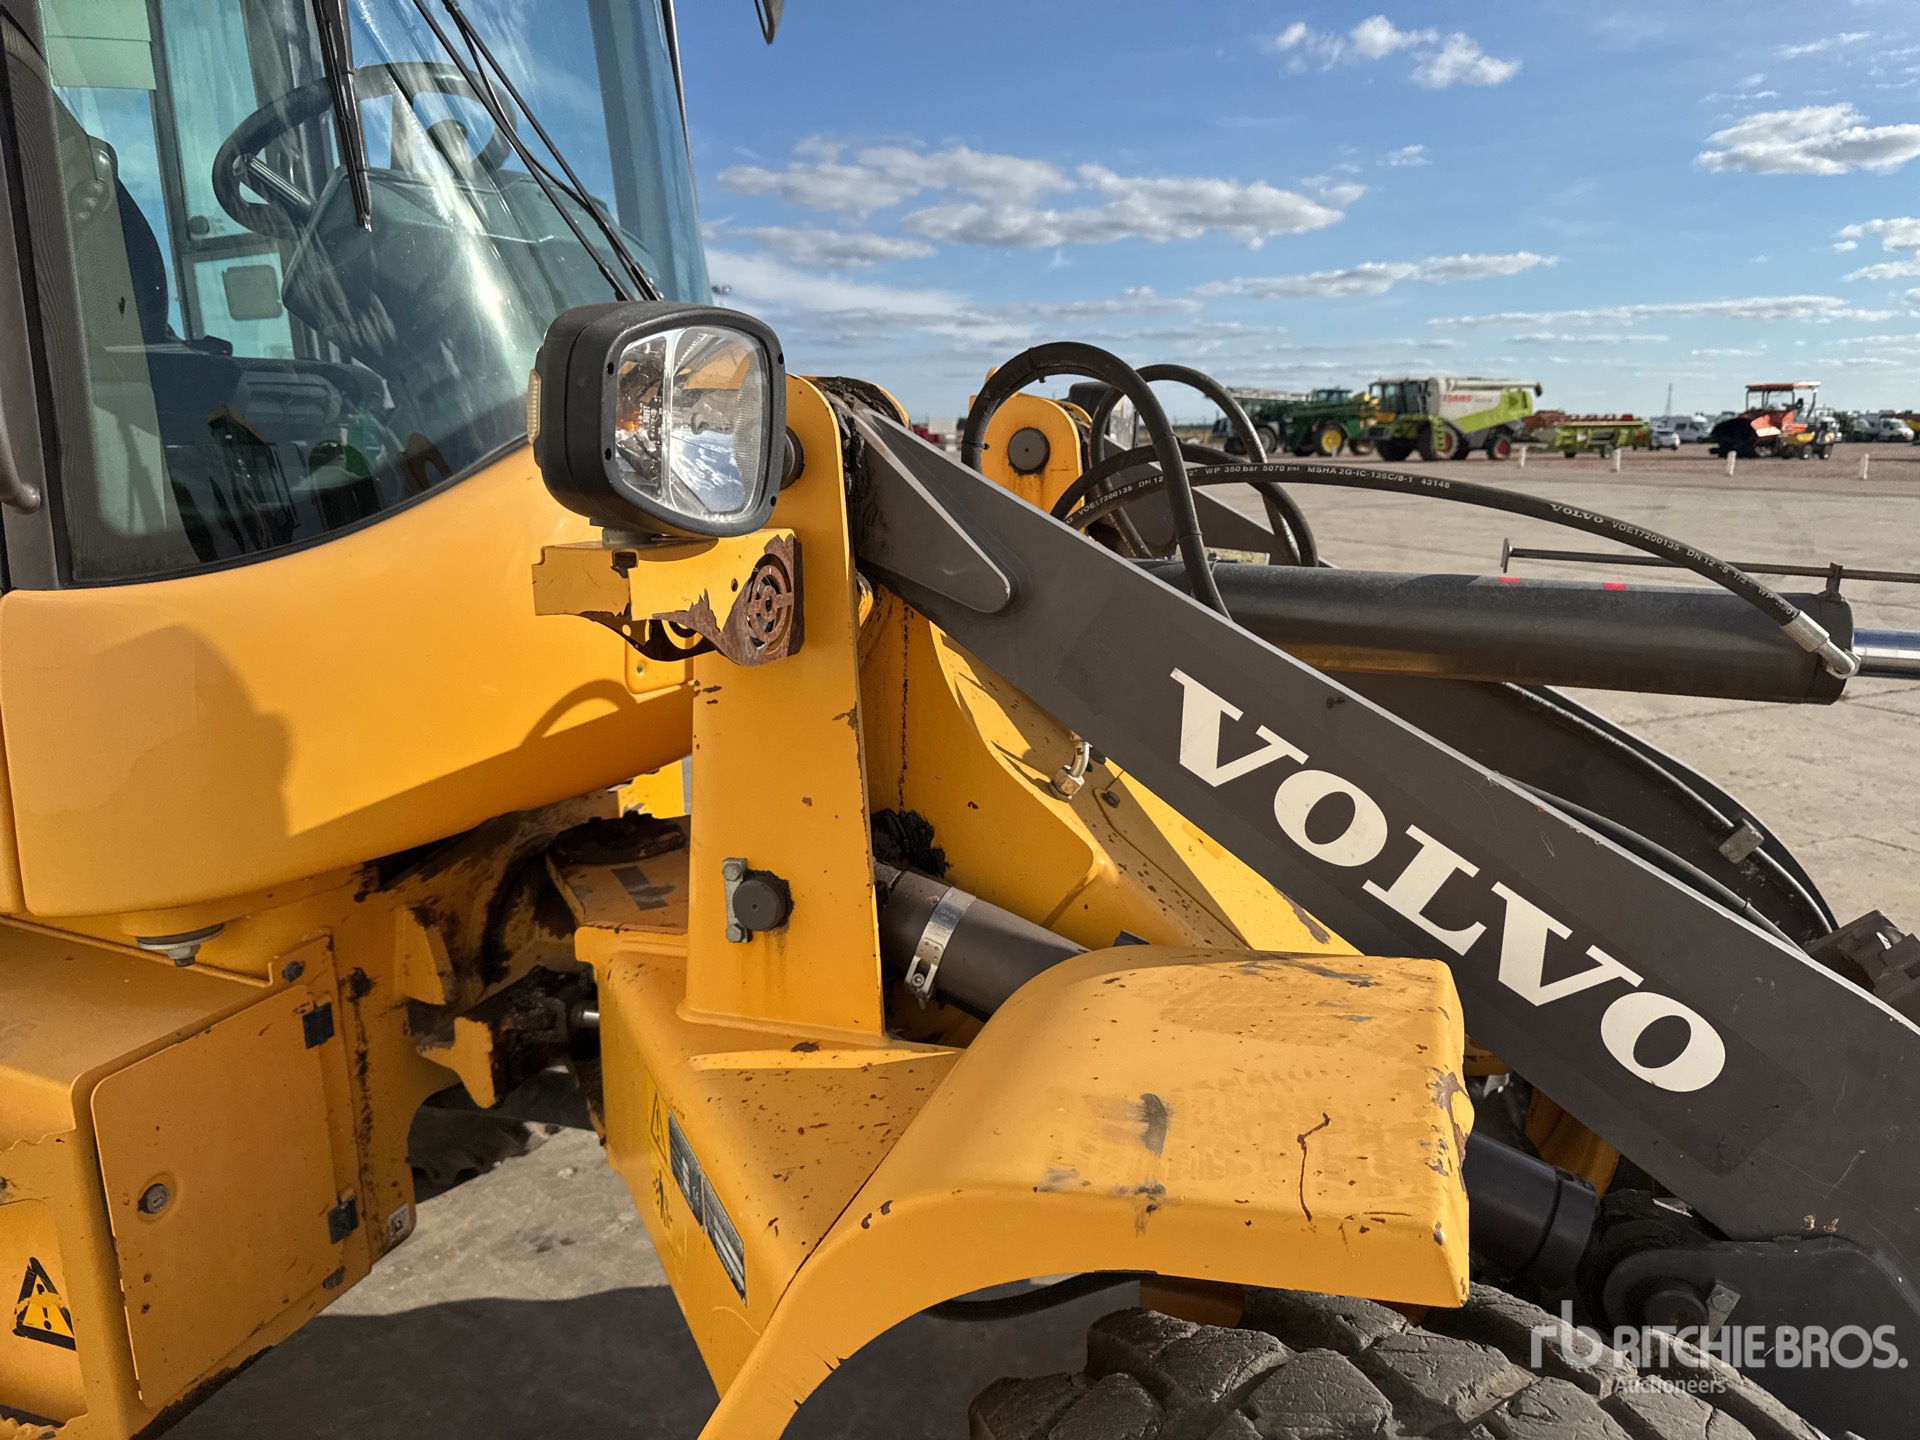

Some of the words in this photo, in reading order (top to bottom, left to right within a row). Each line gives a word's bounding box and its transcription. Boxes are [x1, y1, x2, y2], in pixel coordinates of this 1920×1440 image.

[1078, 485, 1133, 515] VOE17200135
[1138, 480, 1151, 488] DN
[1153, 475, 1164, 483] 12
[1205, 467, 1220, 475] WP
[1224, 465, 1240, 473] 350
[1307, 466, 1337, 475] MSHA
[1549, 503, 1604, 524] VOLVO
[1611, 521, 1680, 551] VOE17200135
[1686, 549, 1701, 560] DN
[1704, 558, 1716, 567] 12
[1758, 586, 1774, 600] WP
[1169, 667, 1726, 1092] VOLVO
